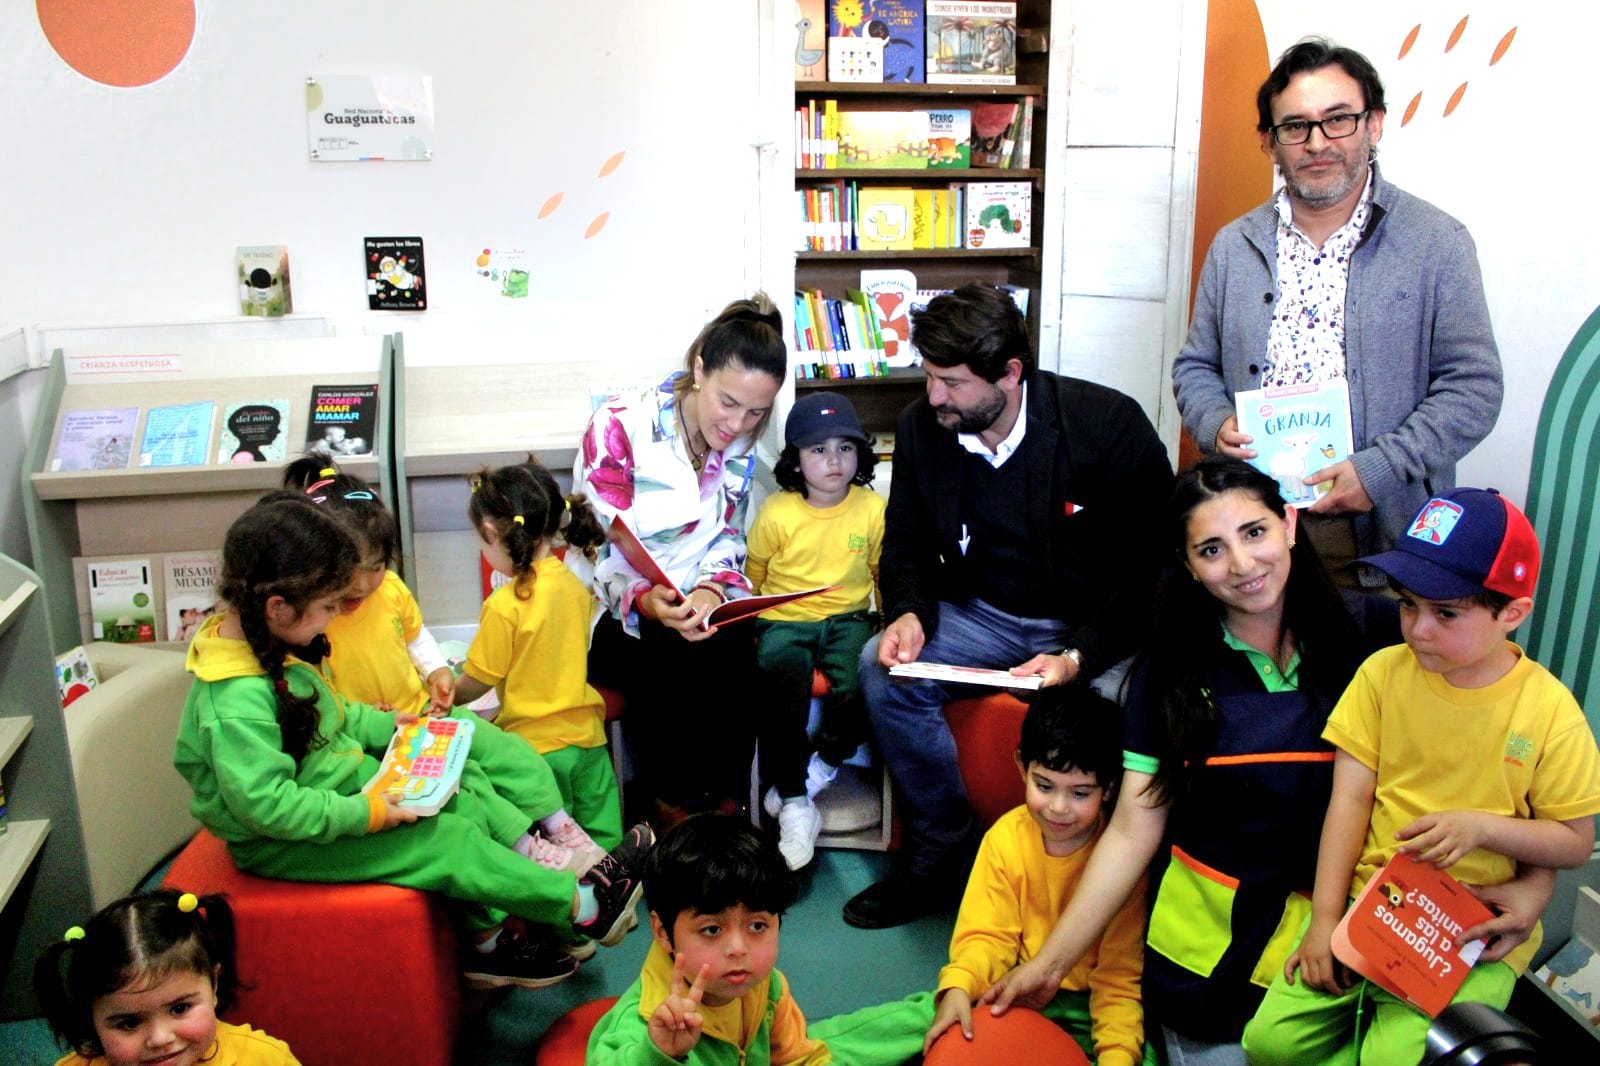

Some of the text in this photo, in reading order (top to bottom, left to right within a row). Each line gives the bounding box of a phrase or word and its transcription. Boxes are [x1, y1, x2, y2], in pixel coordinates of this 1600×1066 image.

[953, 5, 969, 14] VIVEN
[324, 112, 416, 128] Guaguatecas
[929, 113, 954, 123] PERRO
[79, 359, 173, 369] CRIANZA RESPETUOSA
[316, 397, 362, 405] COMER
[315, 405, 350, 413] AMAR
[235, 414, 275, 424] del niño
[314, 412, 360, 420] MAMAR
[1264, 411, 1331, 436] GRANJA
[98, 568, 128, 577] Educar
[1415, 916, 1453, 953] a las
[1373, 904, 1453, 978] ¿Jugamos
